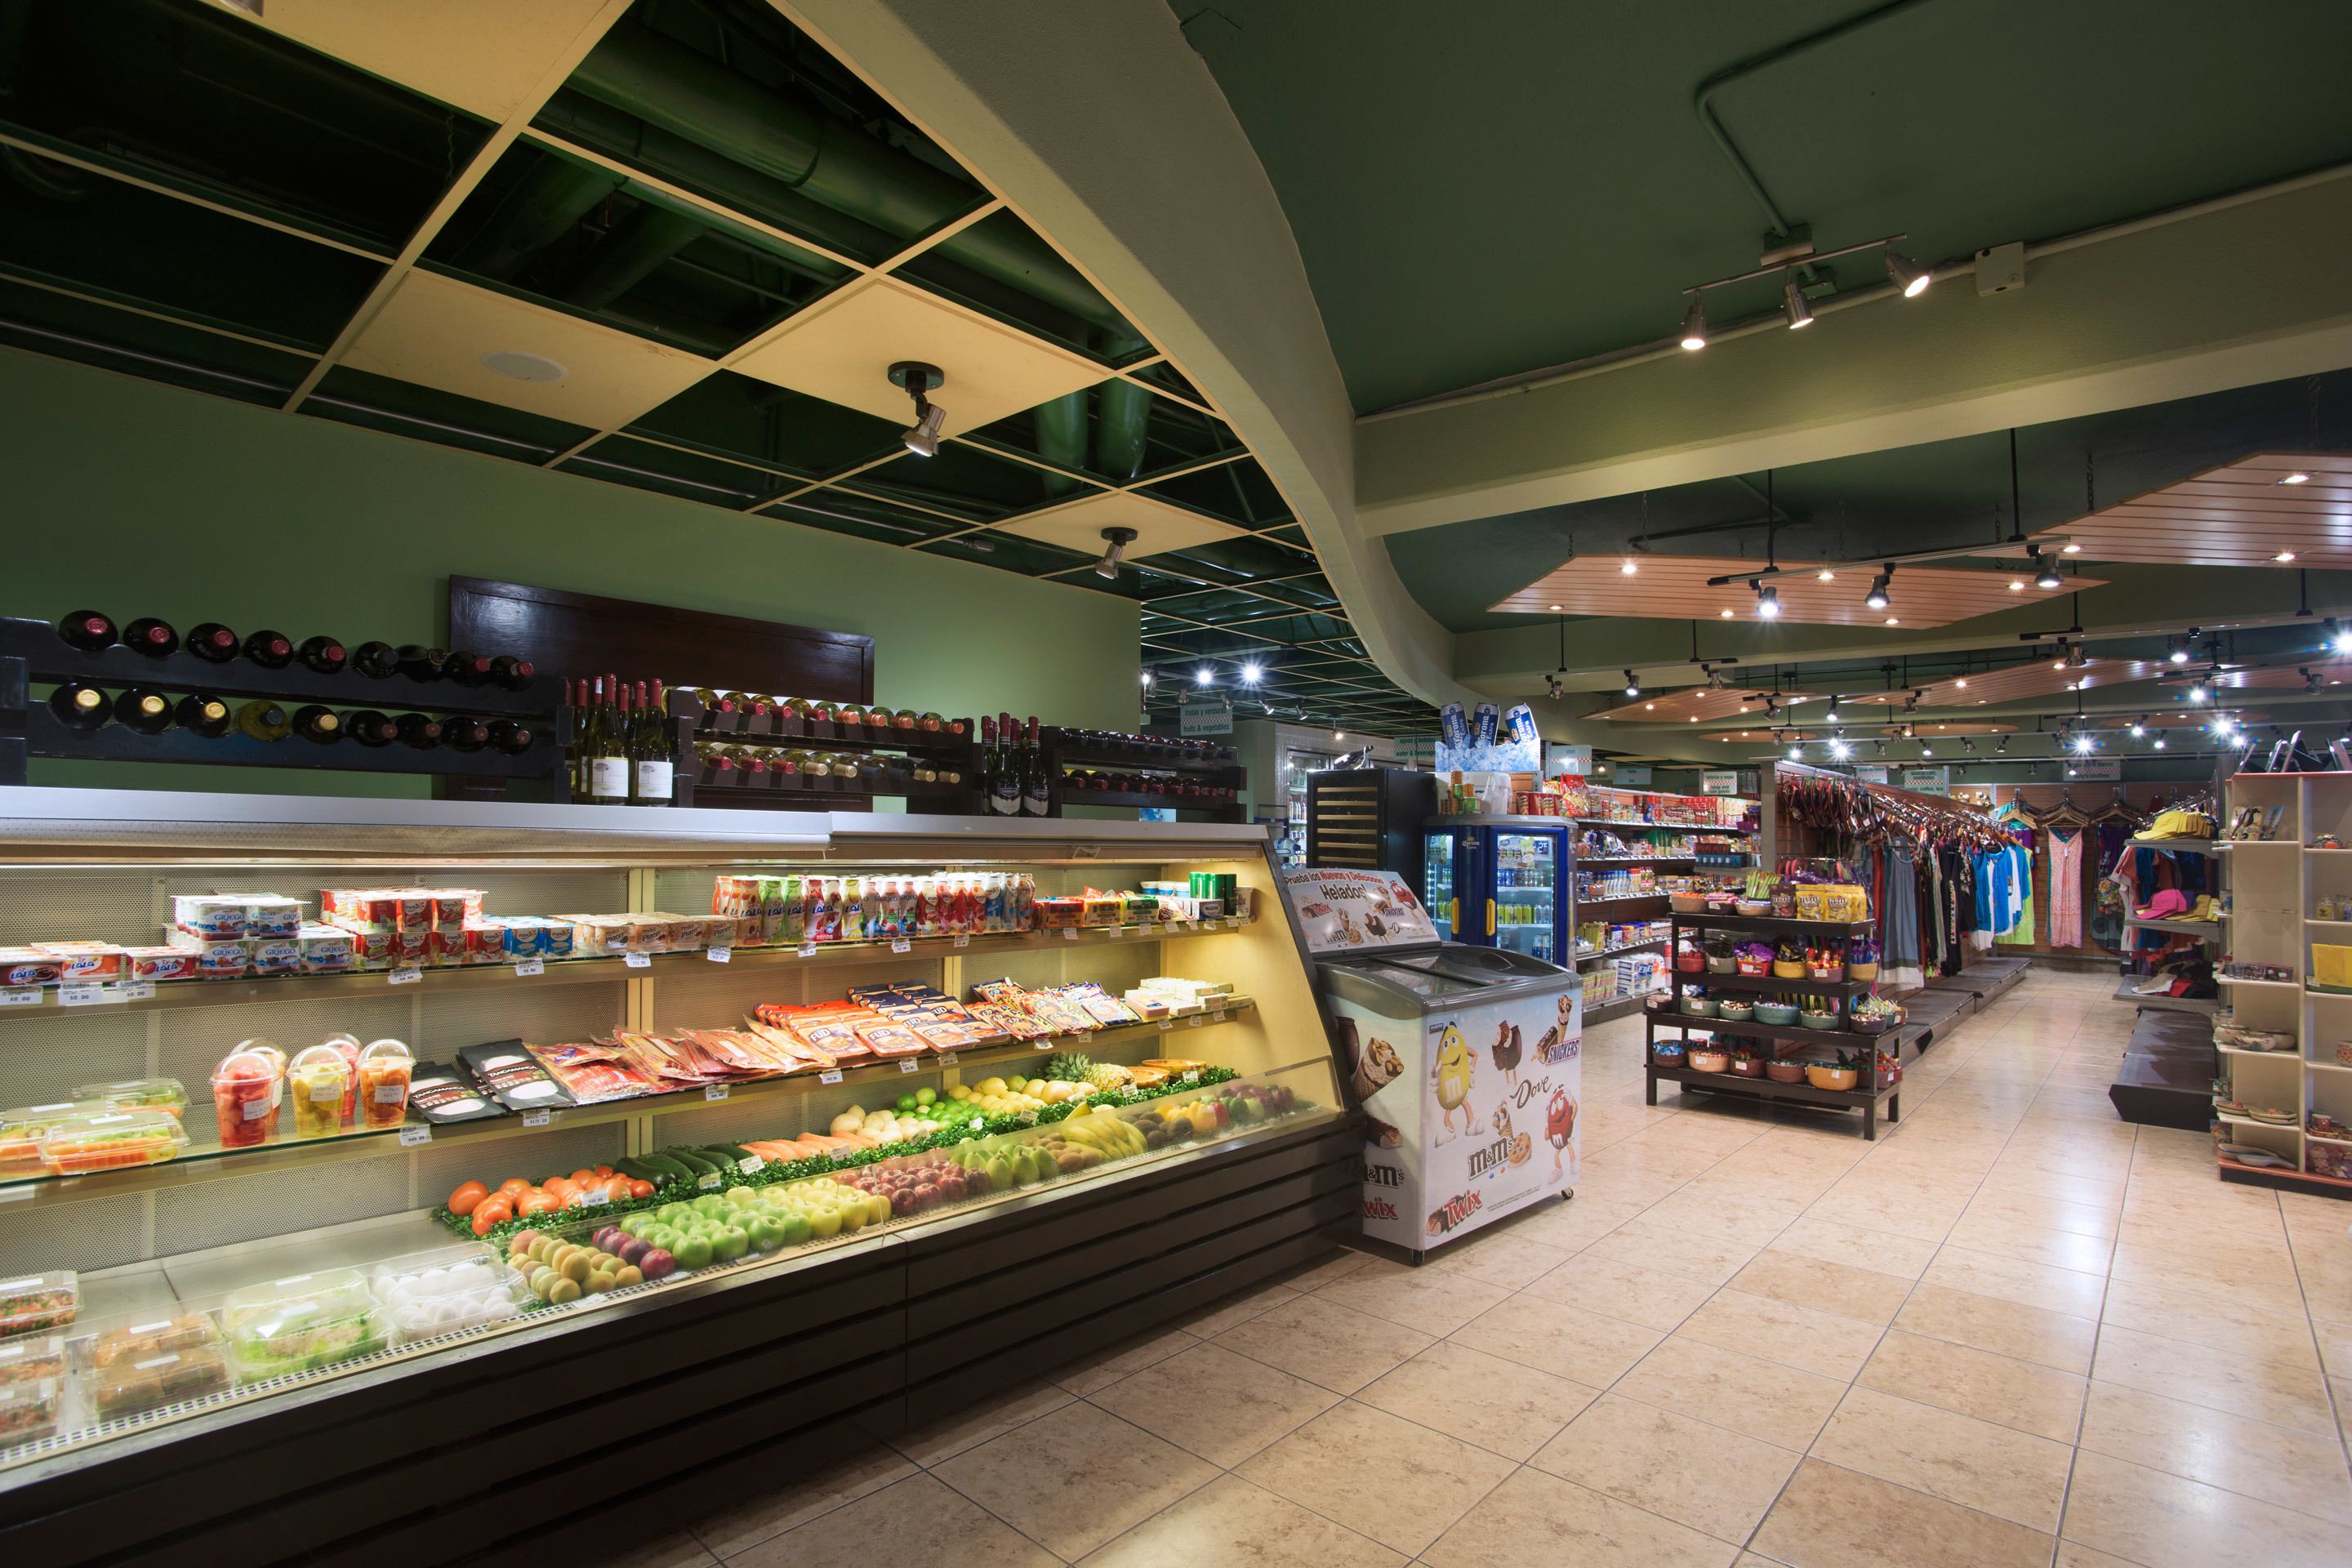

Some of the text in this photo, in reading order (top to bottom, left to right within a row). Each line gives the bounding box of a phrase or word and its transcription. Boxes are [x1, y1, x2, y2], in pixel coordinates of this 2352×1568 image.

[1185, 708, 1199, 716] frutas
[1183, 724, 1196, 733] fruits
[1202, 724, 1230, 733] vegetables
[1486, 722, 1494, 740] Extra
[1285, 872, 1307, 886] Prueba
[1308, 871, 1321, 881] los
[1320, 870, 1347, 880] Nuevos
[1352, 871, 1385, 884] Deliciosos
[1319, 884, 1367, 901] Helados!
[214, 913, 244, 921] GRIEGO
[1385, 907, 1405, 916] SNICKERS
[642, 930, 661, 941] Placer
[680, 928, 698, 939] Placer
[212, 948, 244, 957] GRIEGO
[265, 948, 296, 957] GRIEGO
[320, 946, 348, 954] GRIEGO
[809, 1028, 831, 1042] FUD
[867, 1028, 891, 1041] FUD
[923, 1027, 943, 1038] FUD
[1548, 1039, 1579, 1060] SNICKERS
[488, 1064, 537, 1078] TANGAMANGA
[412, 1085, 466, 1099] TANGAMANGA
[1445, 1076, 1463, 1102] m
[1508, 1076, 1552, 1109] Dove
[1365, 1164, 1405, 1187] &m's
[1364, 1196, 1398, 1219] wix
